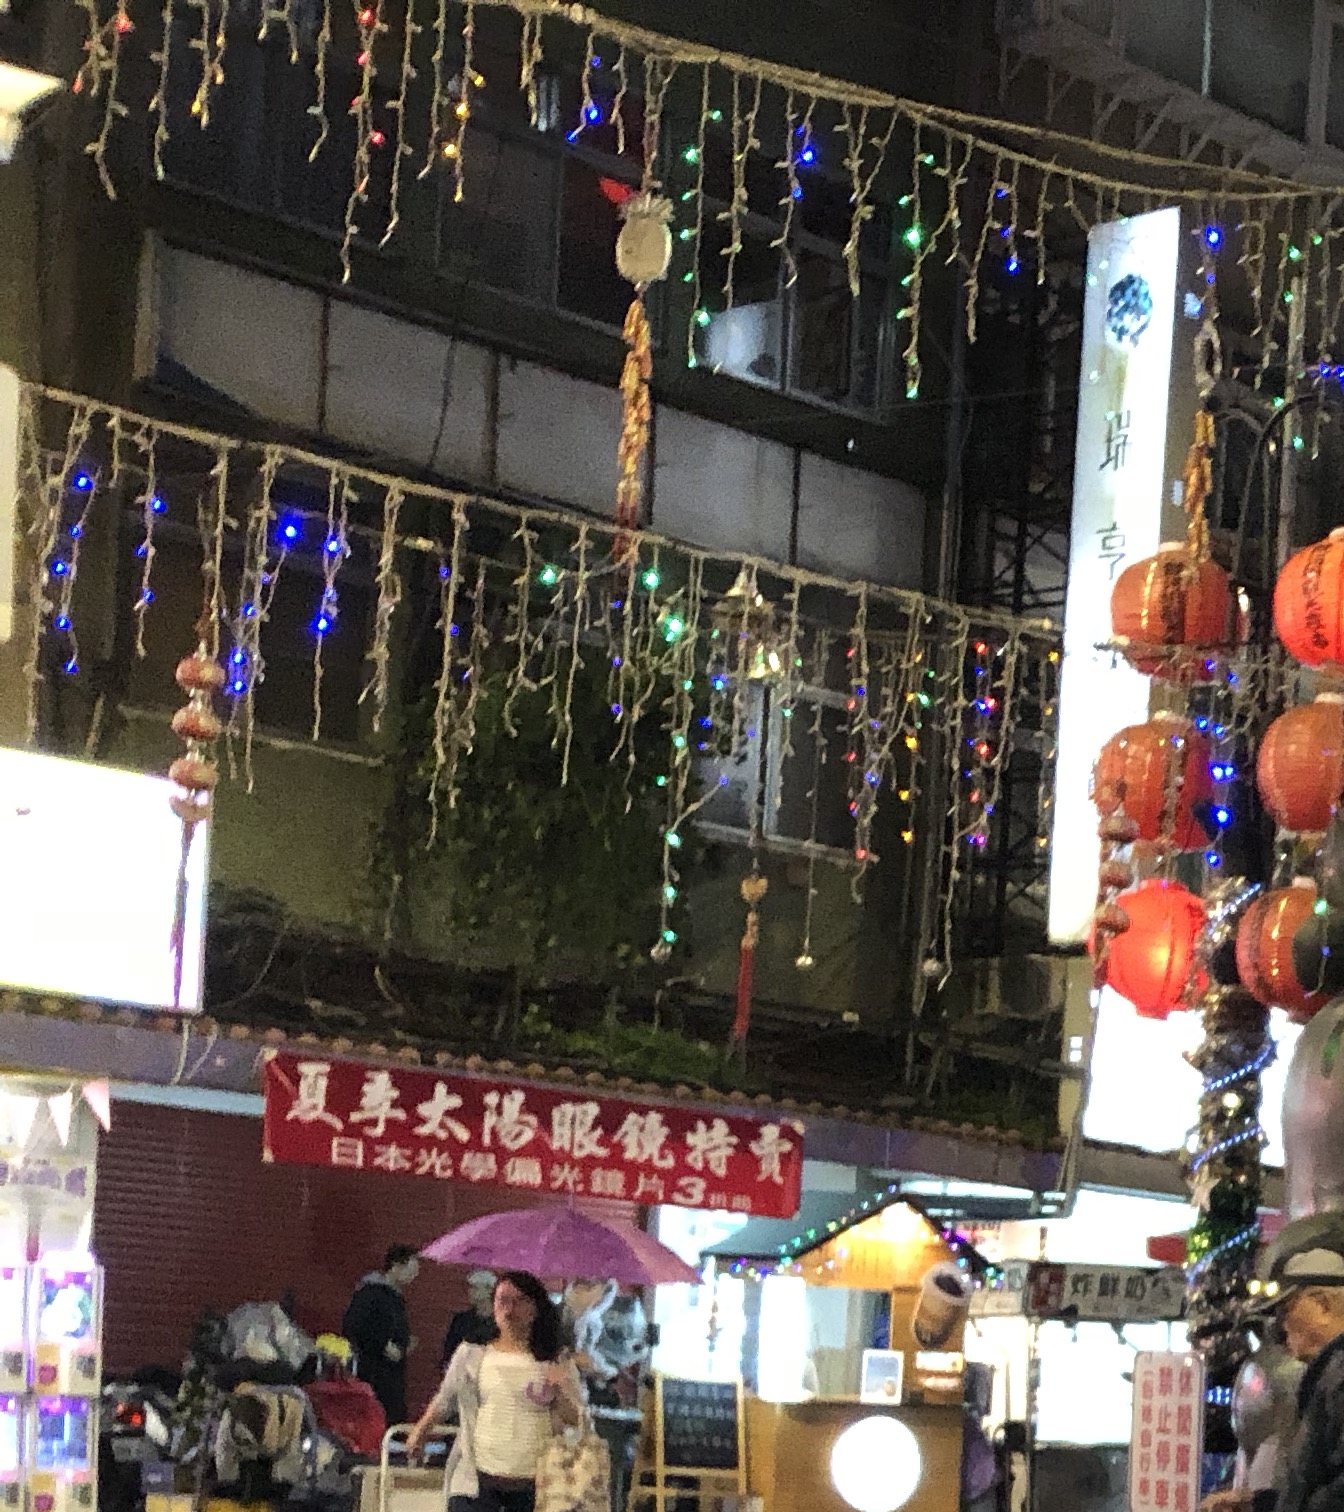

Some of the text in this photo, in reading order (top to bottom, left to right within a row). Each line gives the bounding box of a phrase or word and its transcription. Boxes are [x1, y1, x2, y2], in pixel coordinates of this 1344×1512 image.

[286, 1061, 794, 1185] 夏季太陽眼鏡特賣
[1154, 1365, 1174, 1509] 禁止停車
